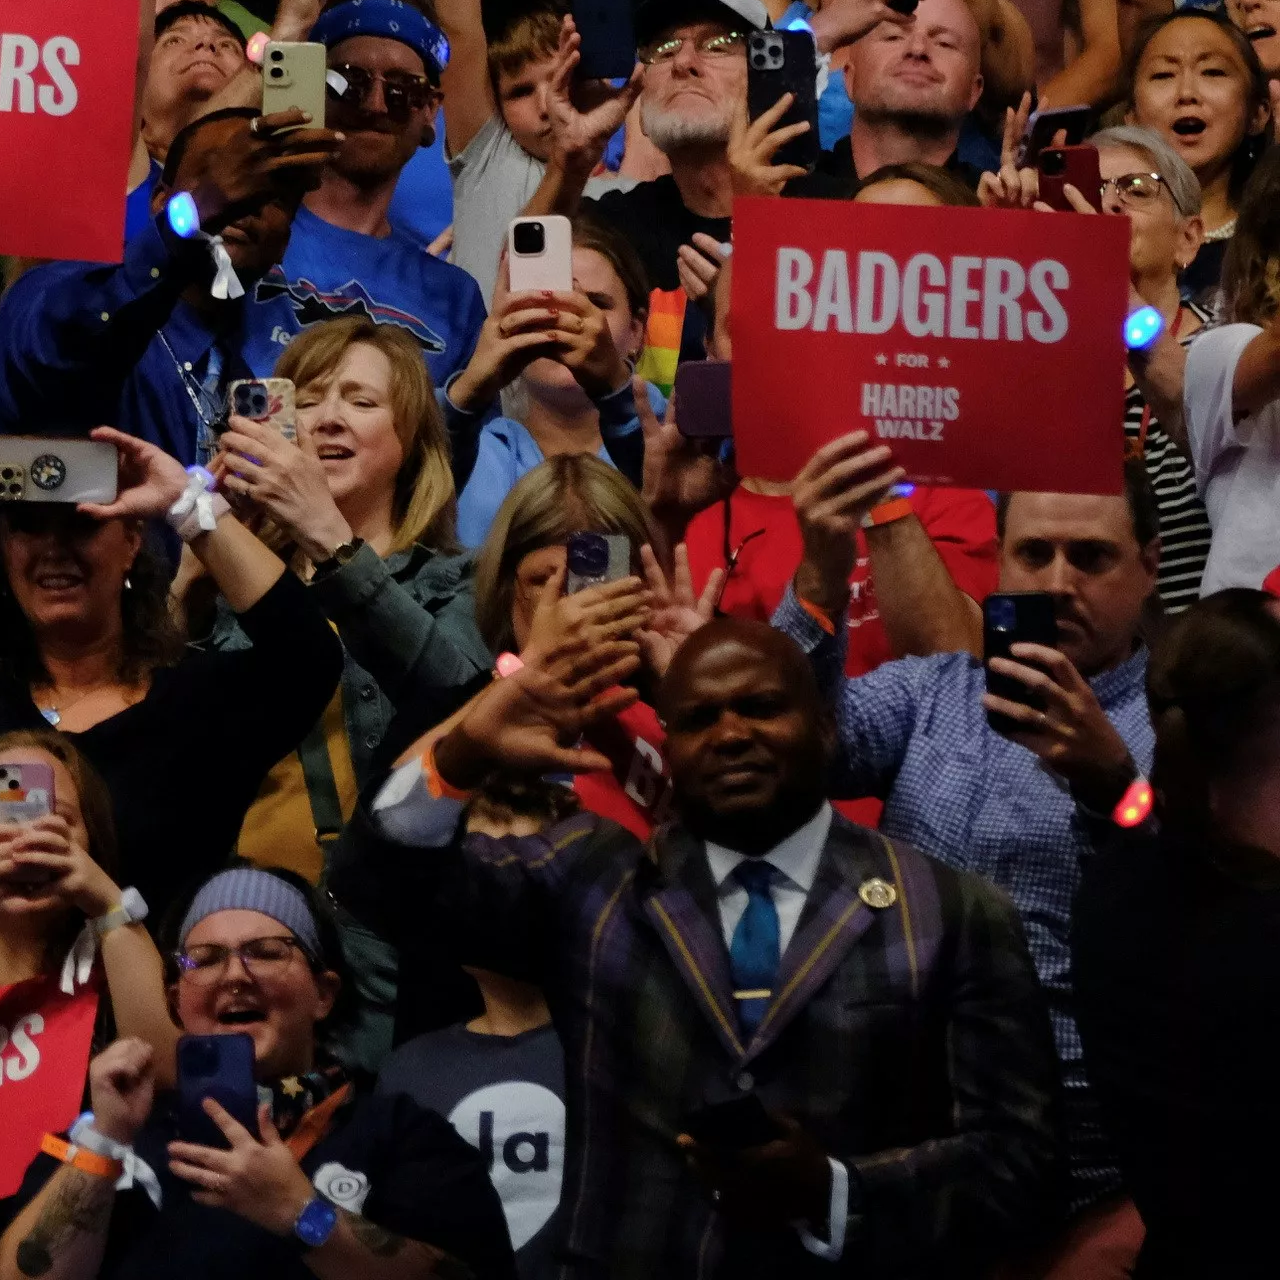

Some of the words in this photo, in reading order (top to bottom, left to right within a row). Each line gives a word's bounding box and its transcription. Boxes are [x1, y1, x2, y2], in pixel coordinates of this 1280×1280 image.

[776, 247, 1069, 343] BADGERS
[896, 353, 929, 367] FOR
[860, 383, 959, 420] HARRIS
[875, 417, 945, 441] WALZ
